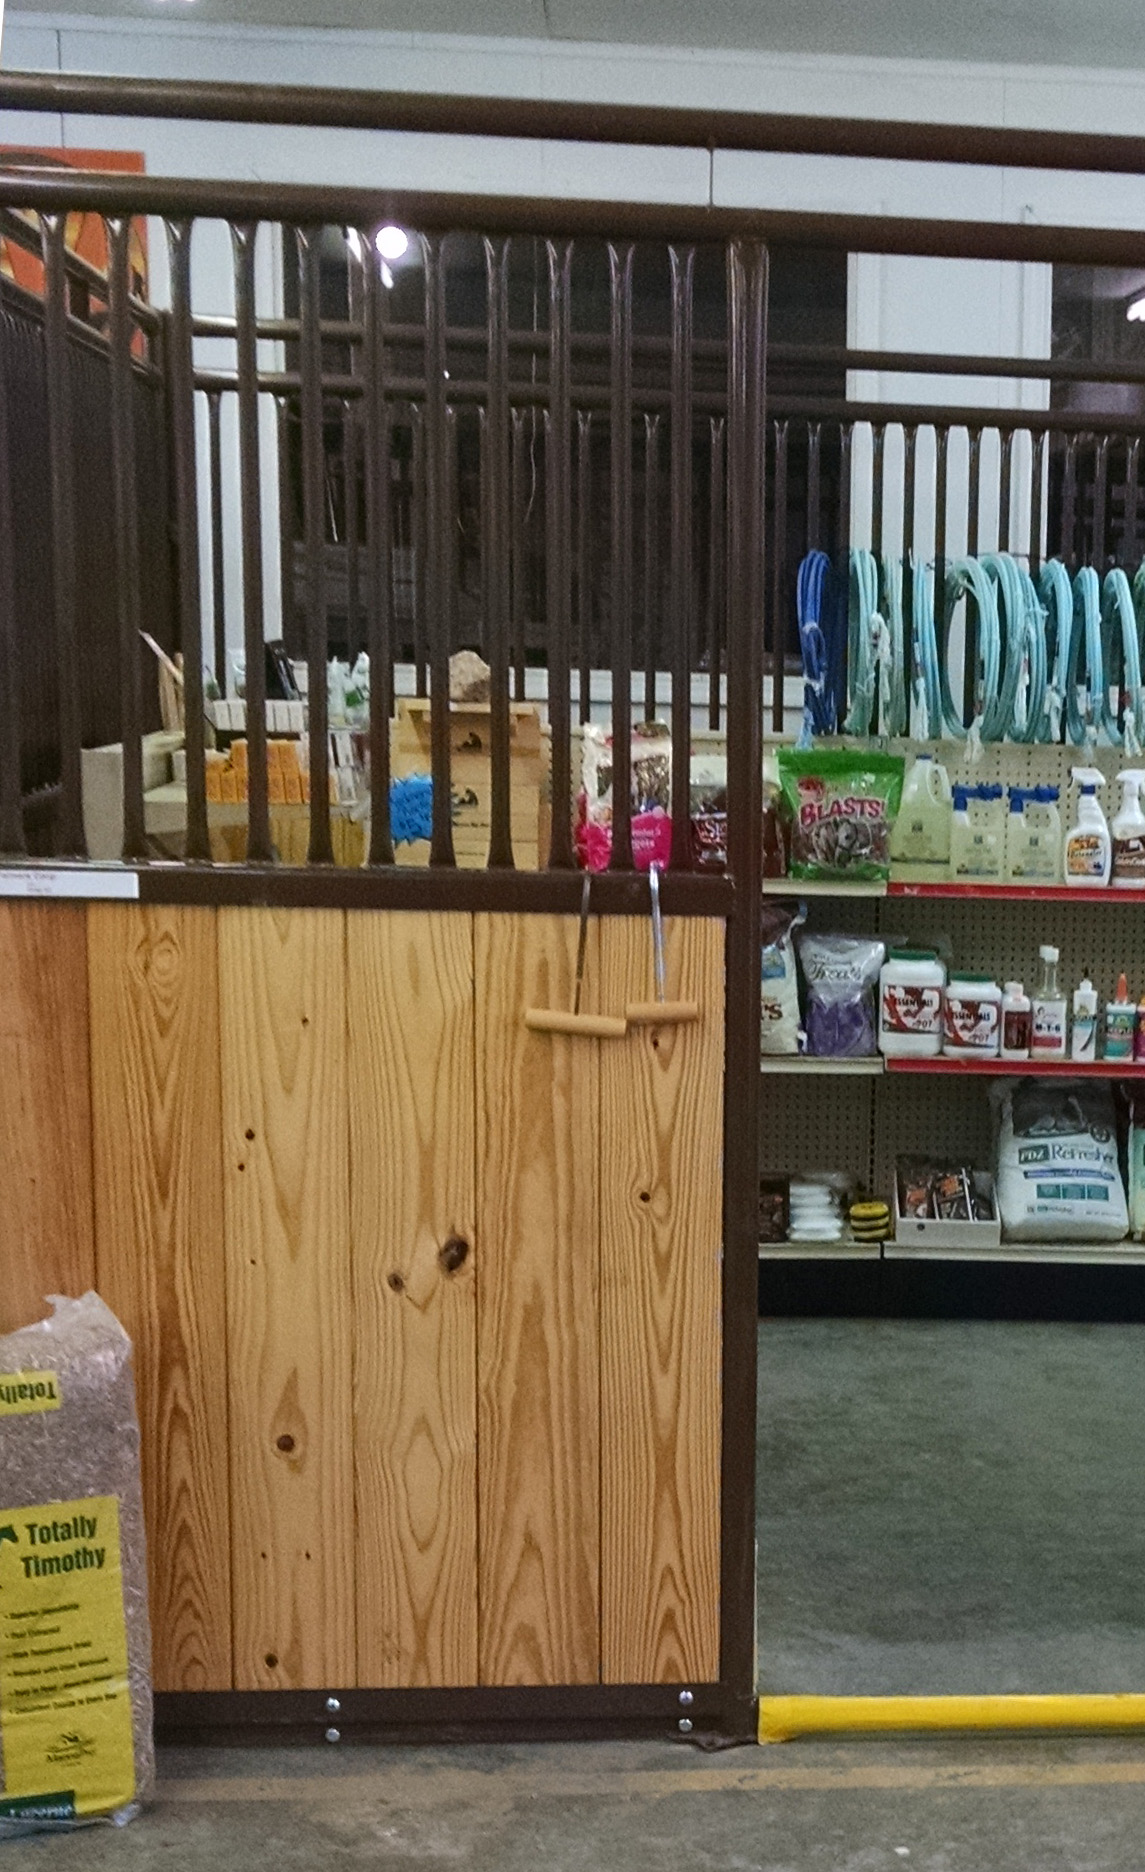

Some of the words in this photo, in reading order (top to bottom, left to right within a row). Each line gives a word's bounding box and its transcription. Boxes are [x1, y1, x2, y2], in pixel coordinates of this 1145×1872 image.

[800, 796, 885, 828] BLASTS!
[24, 1515, 98, 1545] Totally
[21, 1546, 106, 1578] Timothy
